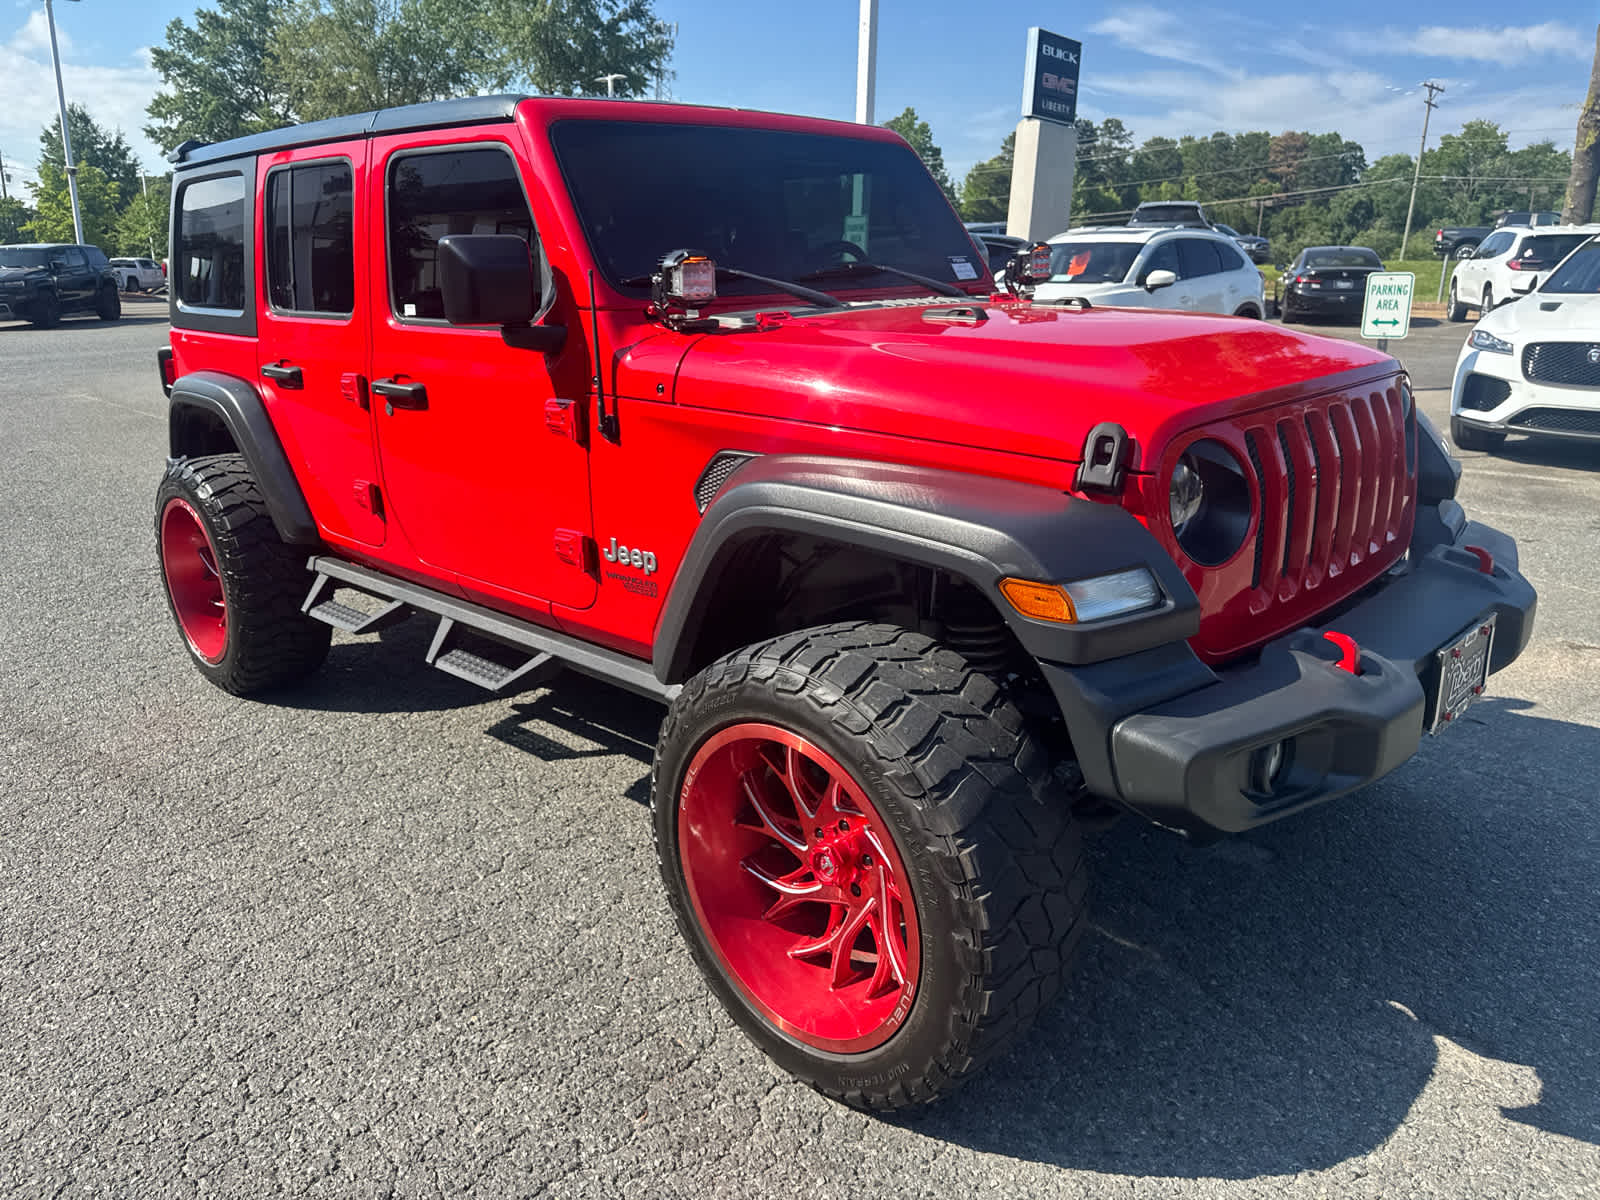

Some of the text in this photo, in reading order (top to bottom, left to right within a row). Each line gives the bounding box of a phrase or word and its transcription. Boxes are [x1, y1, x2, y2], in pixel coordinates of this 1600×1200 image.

[1042, 44, 1078, 64] BUICK
[1042, 72, 1075, 95] GMC
[1041, 98, 1070, 113] LIBERTY
[1371, 284, 1409, 296] PARKING
[1376, 300, 1399, 311] AREA
[603, 537, 658, 576] Jeep
[680, 766, 698, 811] FUEL
[886, 980, 914, 1026] FUEL
